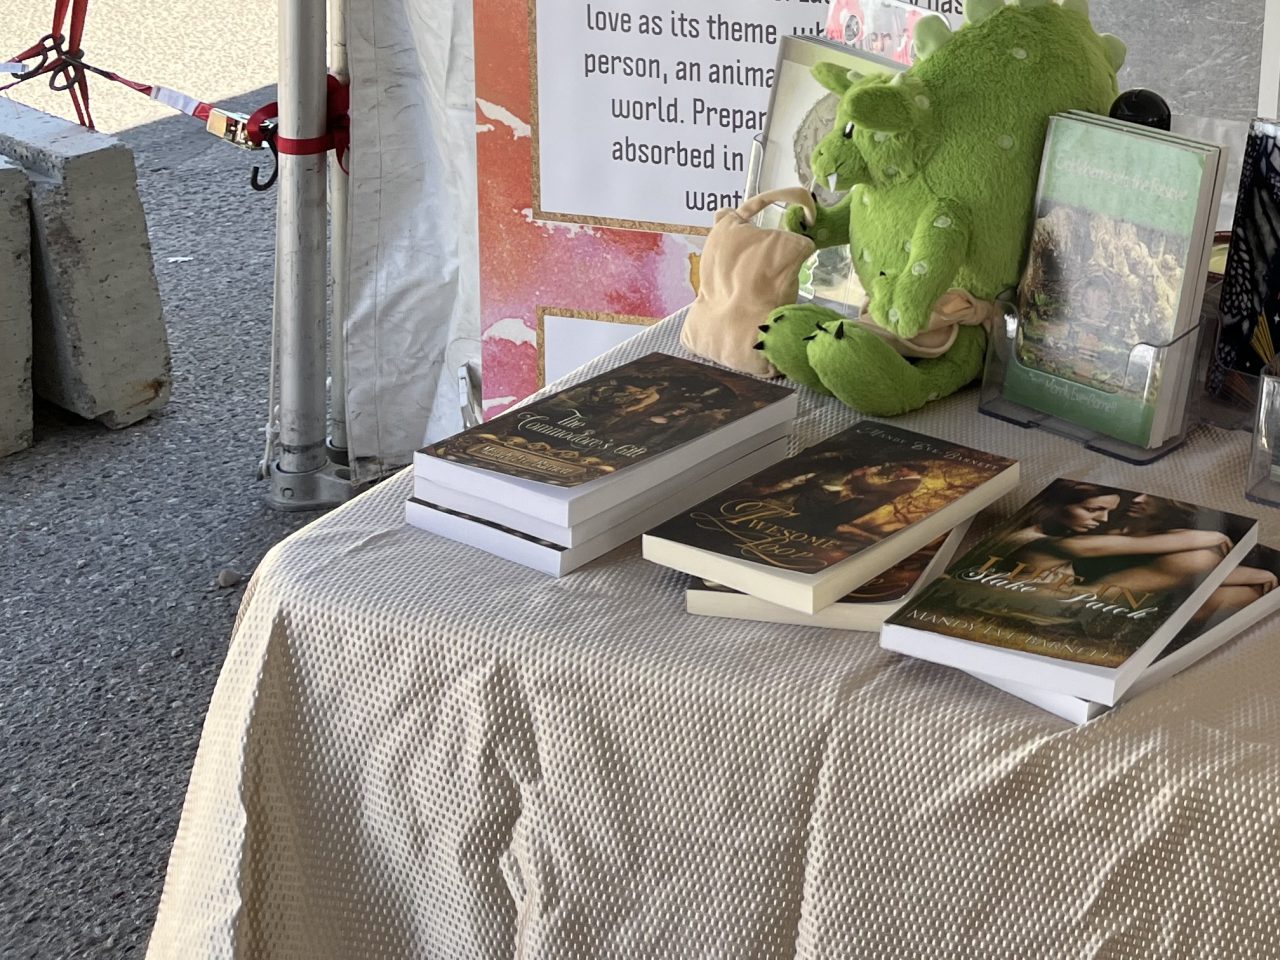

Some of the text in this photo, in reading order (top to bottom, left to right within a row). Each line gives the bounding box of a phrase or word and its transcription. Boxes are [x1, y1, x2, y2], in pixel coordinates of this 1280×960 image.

[586, 3, 632, 33] love
[638, 13, 663, 35] as
[671, 10, 700, 39] its
[706, 13, 777, 45] theme
[584, 52, 775, 88] person, an anima
[611, 96, 767, 133] world. Prepar
[612, 136, 744, 172] absorbed in
[685, 190, 743, 212] want
[959, 565, 1039, 593] Slake
